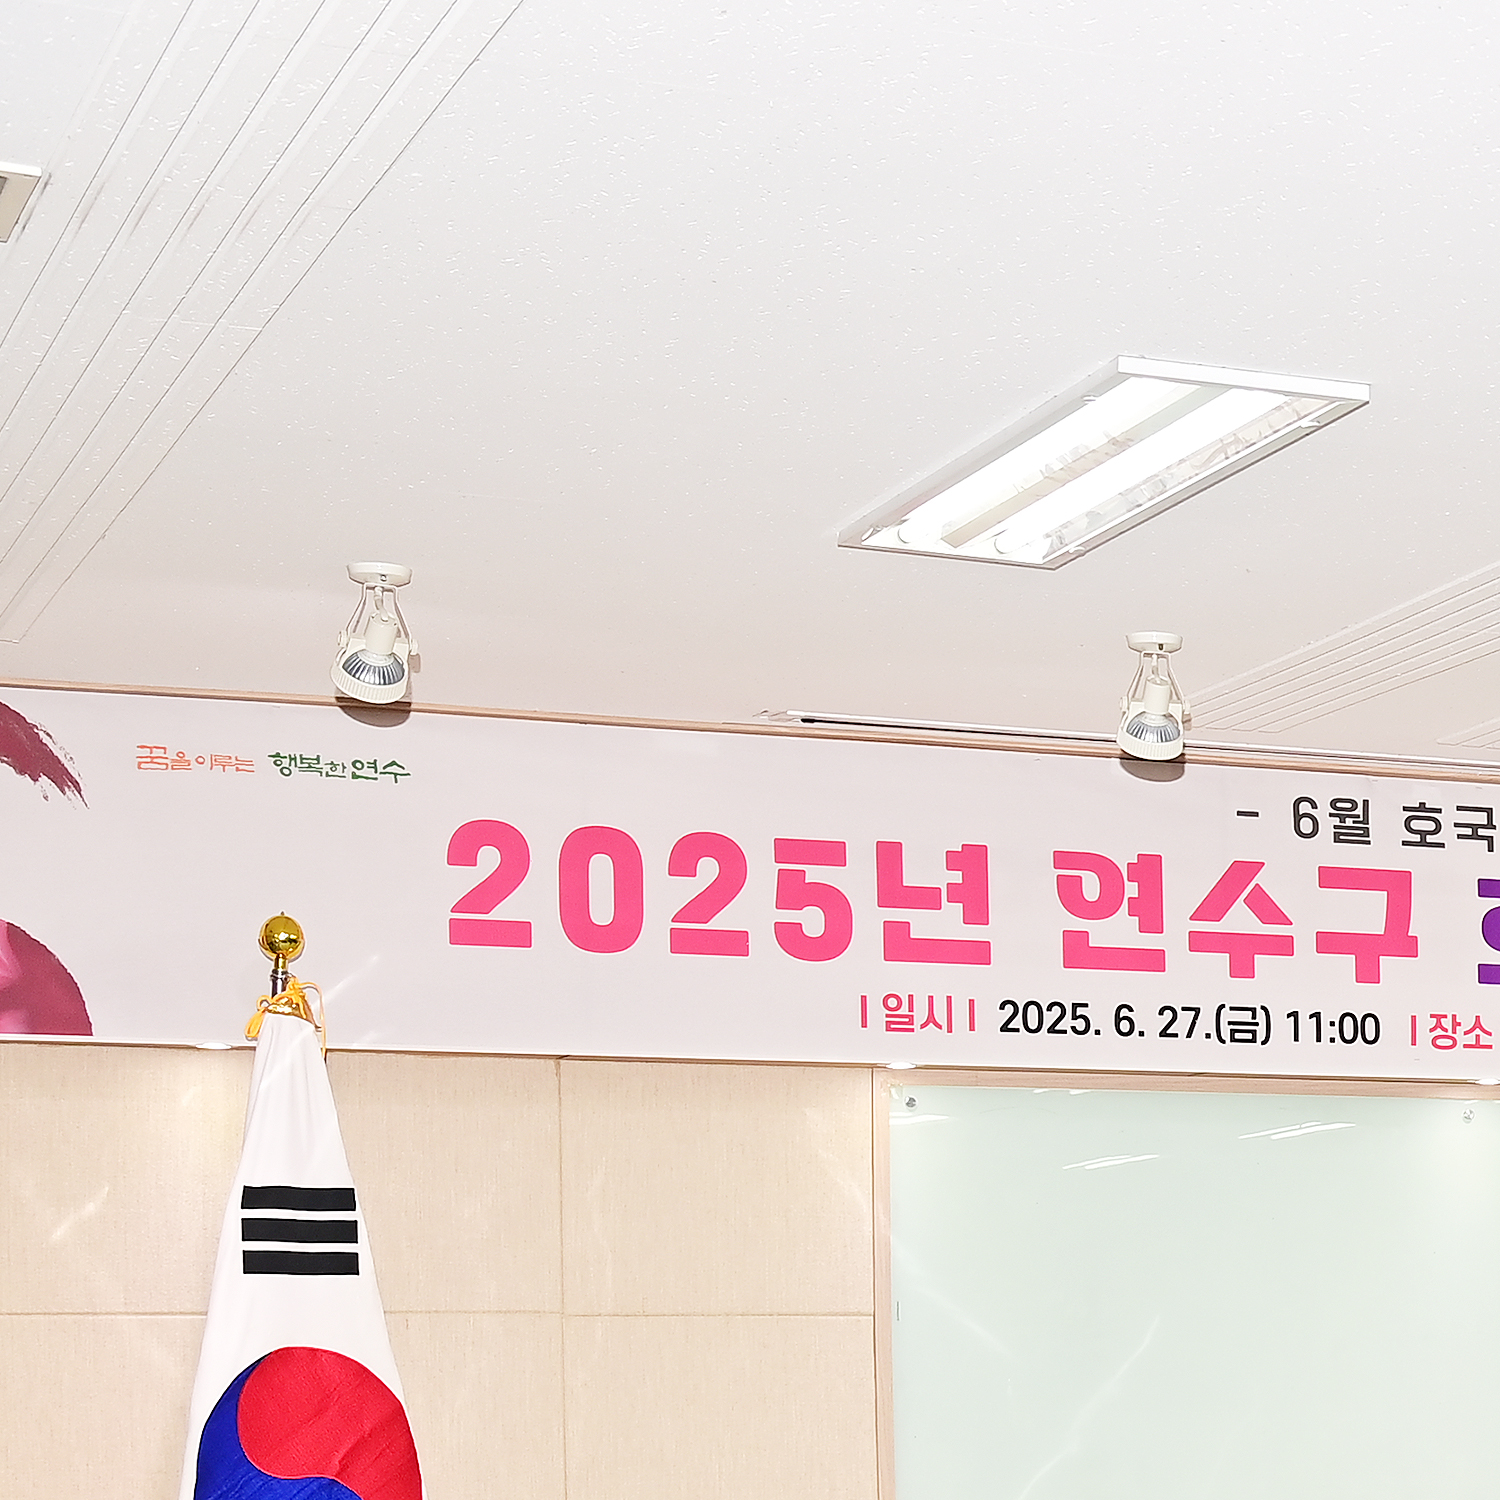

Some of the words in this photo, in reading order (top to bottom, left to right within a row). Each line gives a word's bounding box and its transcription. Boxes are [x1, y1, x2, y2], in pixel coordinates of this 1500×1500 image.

[1292, 796, 1372, 846] 6월
[446, 819, 992, 966] 2025년
[1052, 850, 1419, 985] 연수구
[998, 999, 1102, 1037] 2025.
[1113, 1003, 1145, 1038] 6.
[1157, 1003, 1272, 1046] 27.(금)
[1286, 1010, 1382, 1047] 11:00
